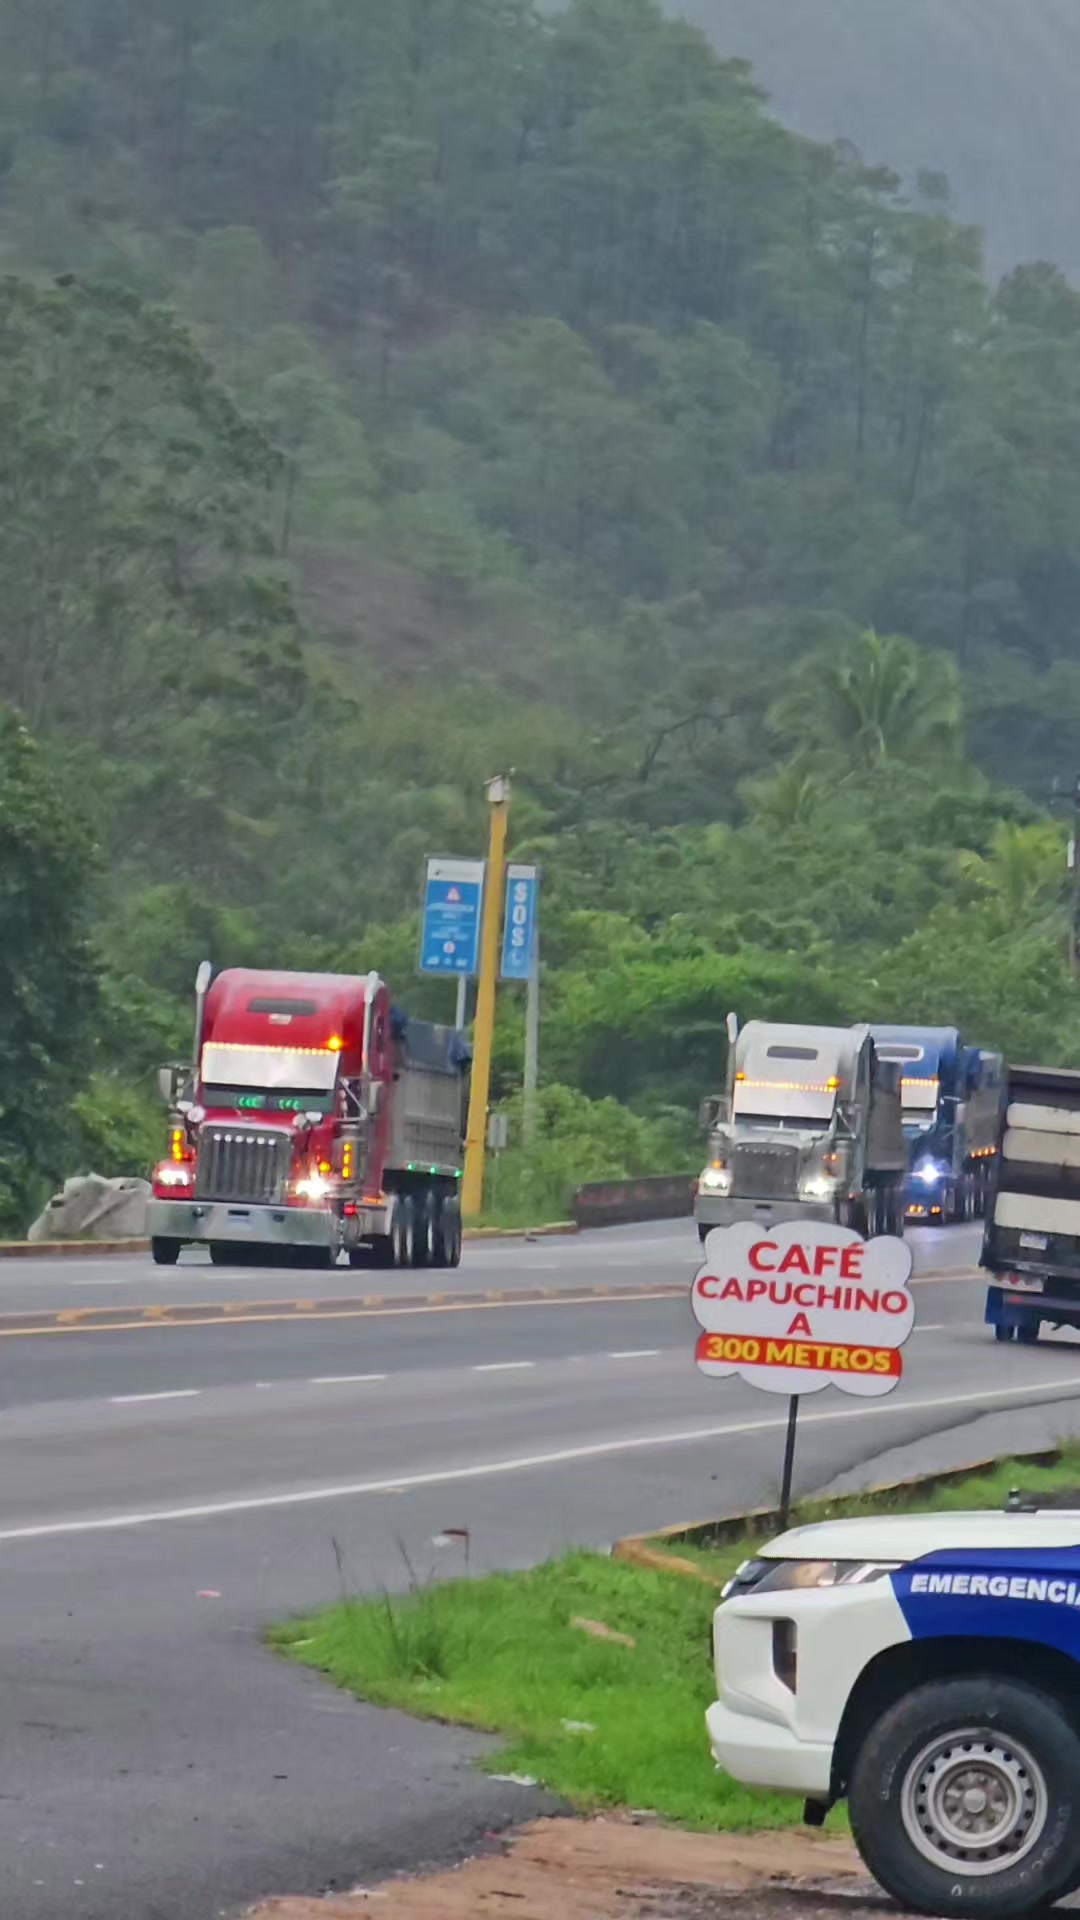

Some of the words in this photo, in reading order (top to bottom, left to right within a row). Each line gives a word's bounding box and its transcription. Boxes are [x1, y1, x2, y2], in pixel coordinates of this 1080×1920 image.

[511, 881, 527, 947] SOS
[748, 1241, 864, 1279] CAFÉ
[696, 1275, 908, 1315] CAPUCHINO
[787, 1312, 812, 1336] A
[707, 1337, 760, 1361] 300
[766, 1341, 891, 1373] METROS
